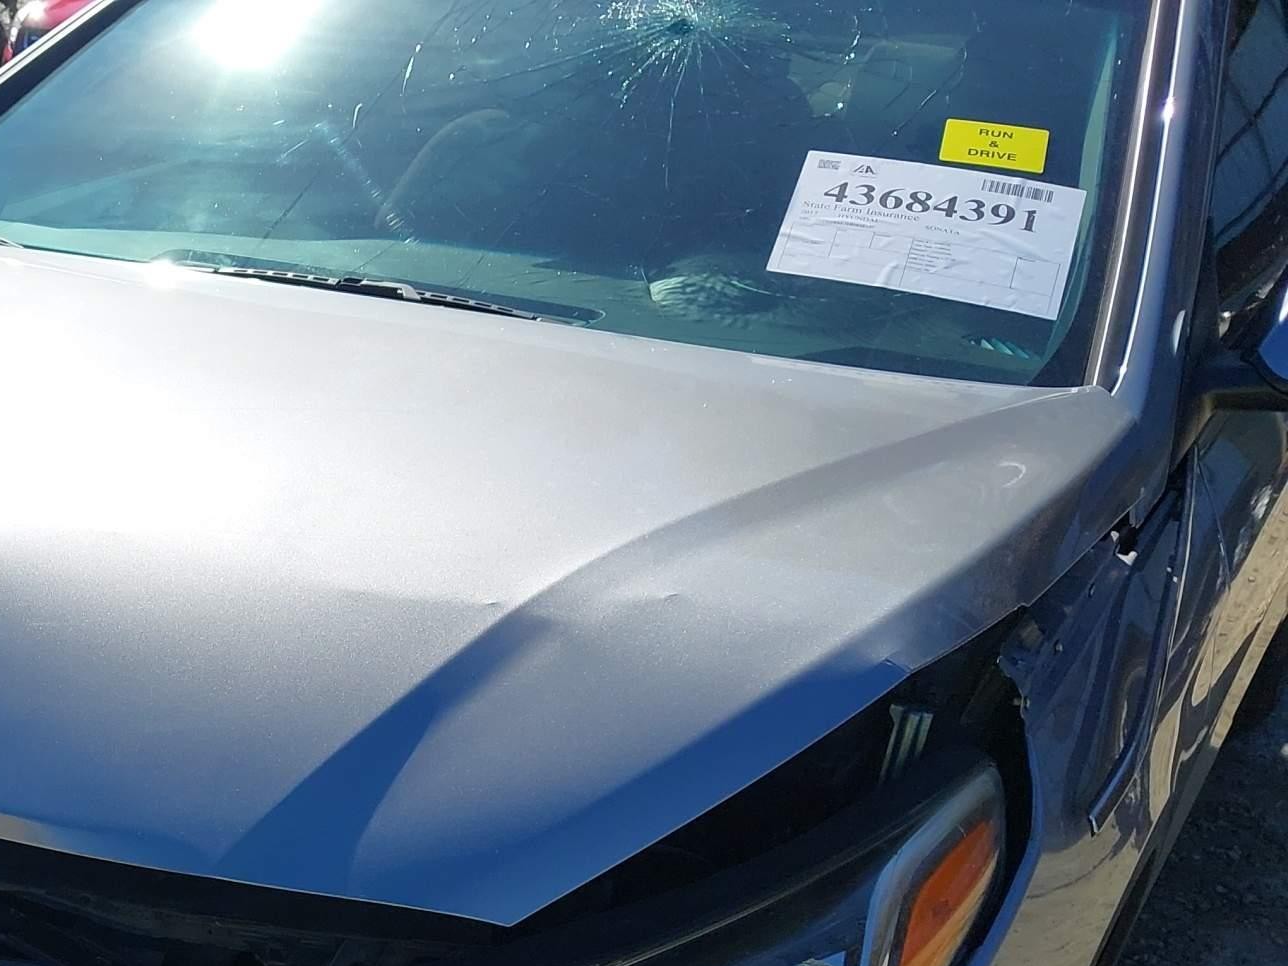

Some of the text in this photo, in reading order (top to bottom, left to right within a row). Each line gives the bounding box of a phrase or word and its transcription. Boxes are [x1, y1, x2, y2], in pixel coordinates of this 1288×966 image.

[979, 128, 1014, 139] RUN
[988, 140, 999, 148] &
[967, 148, 1017, 161] DRIVE
[803, 200, 921, 222] State Farm Insurance
[824, 181, 1039, 233] 43684391
[924, 225, 961, 236] SONATA
